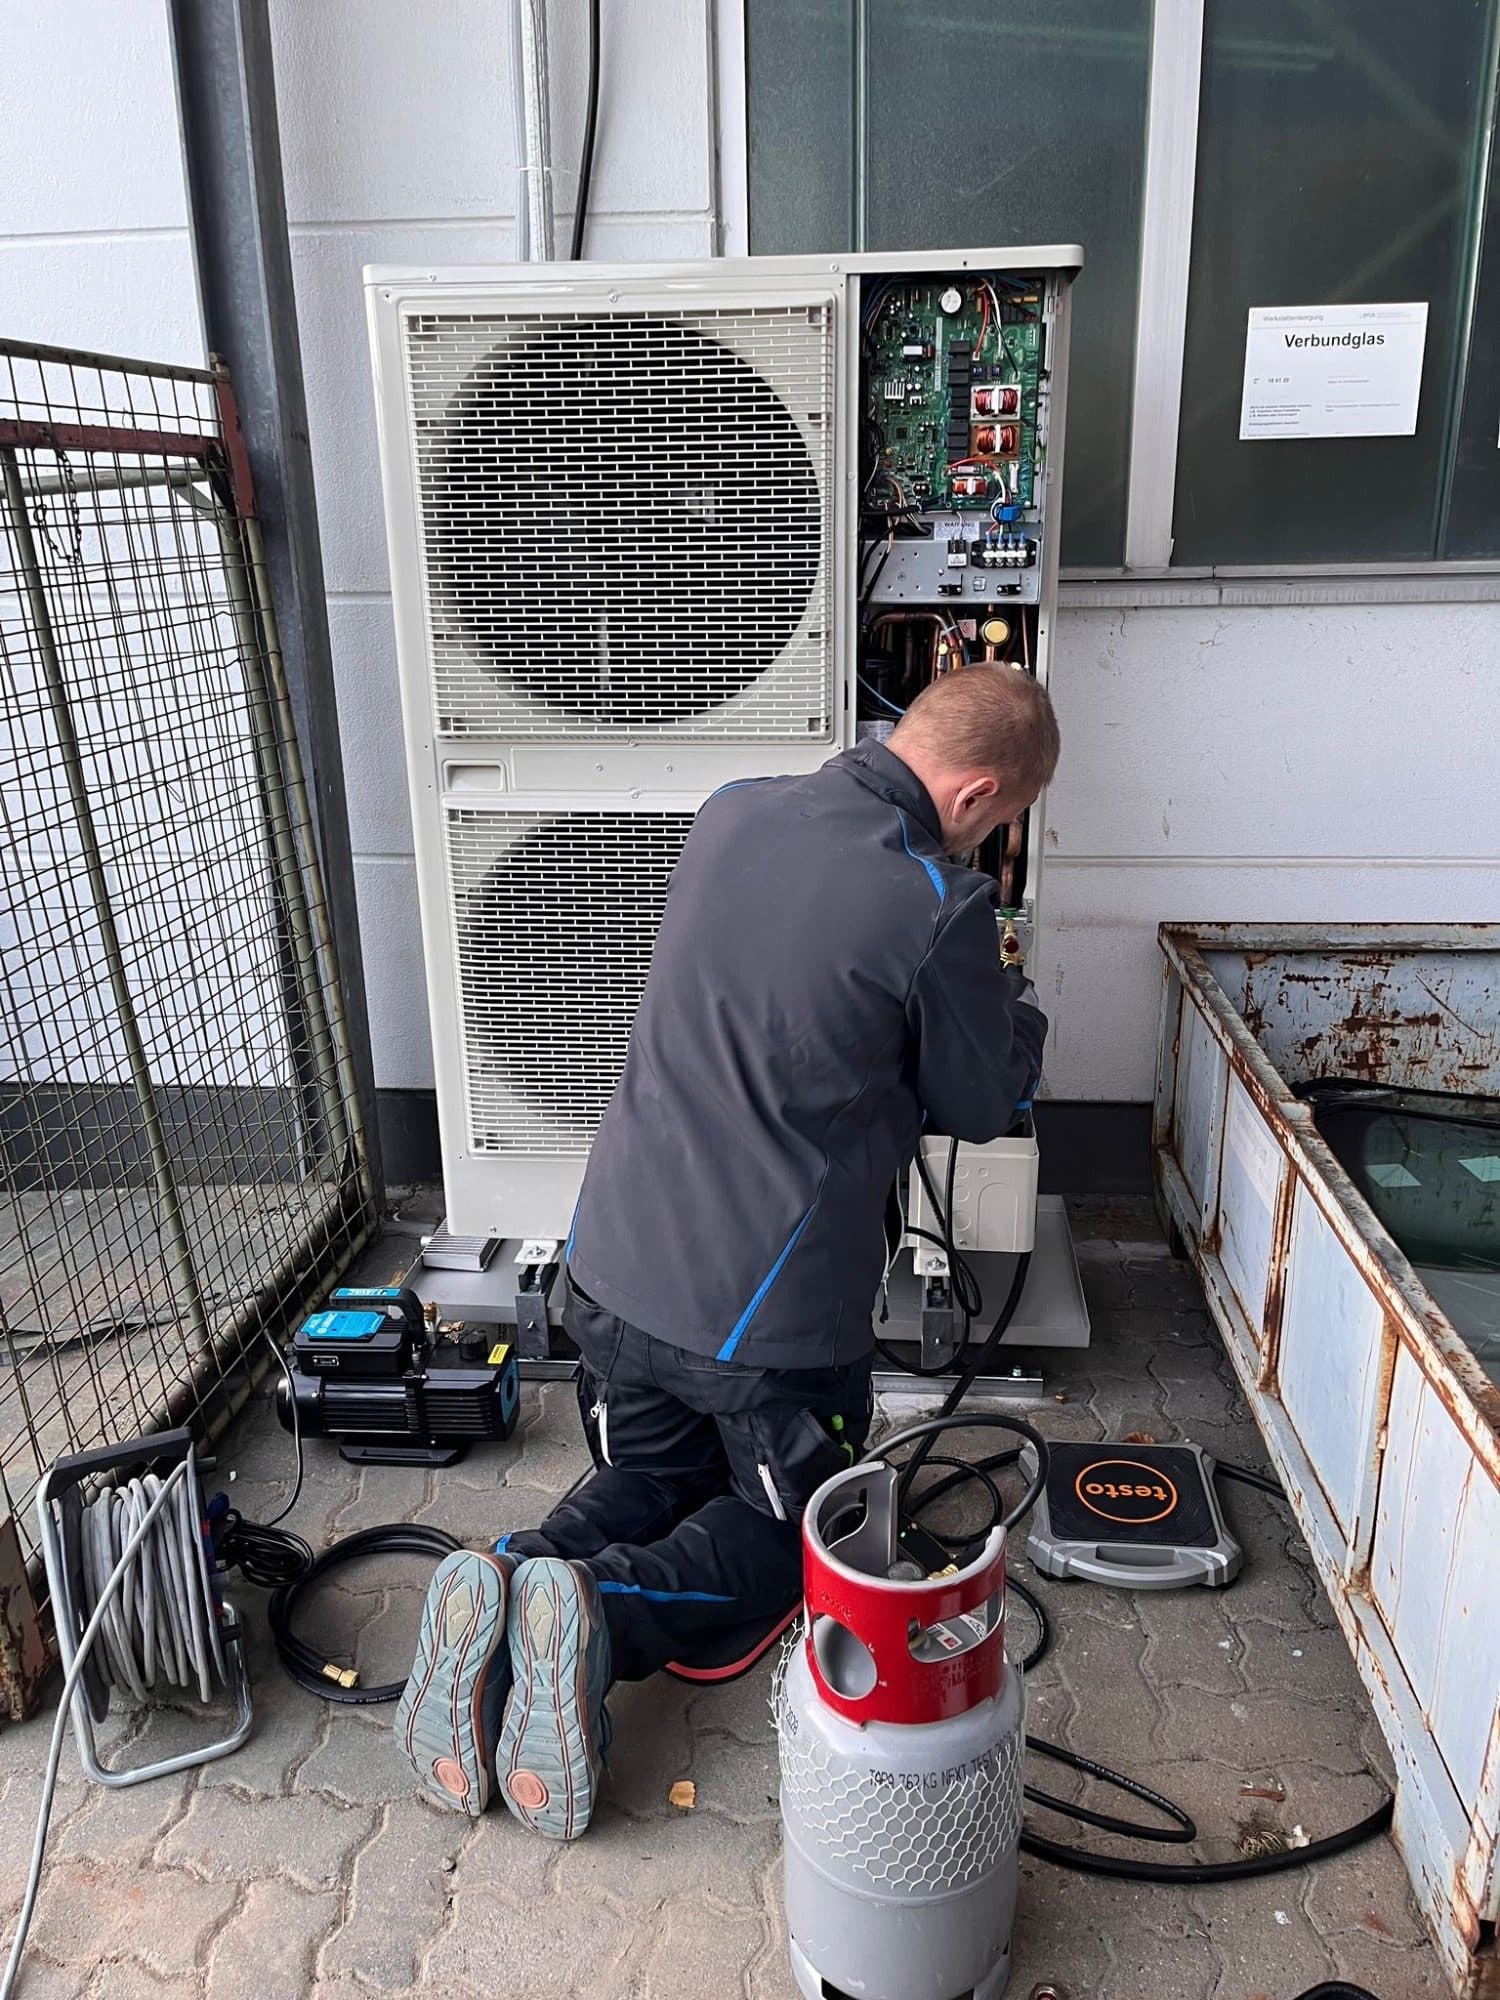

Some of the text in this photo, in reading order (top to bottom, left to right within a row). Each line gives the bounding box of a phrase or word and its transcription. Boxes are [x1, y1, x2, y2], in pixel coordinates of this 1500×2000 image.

[1285, 332, 1385, 349] Verbundglas
[1085, 1483, 1168, 1500] testo
[923, 1772, 938, 1789] KG
[941, 1763, 967, 1787] NEXT
[971, 1748, 993, 1772] TEST
